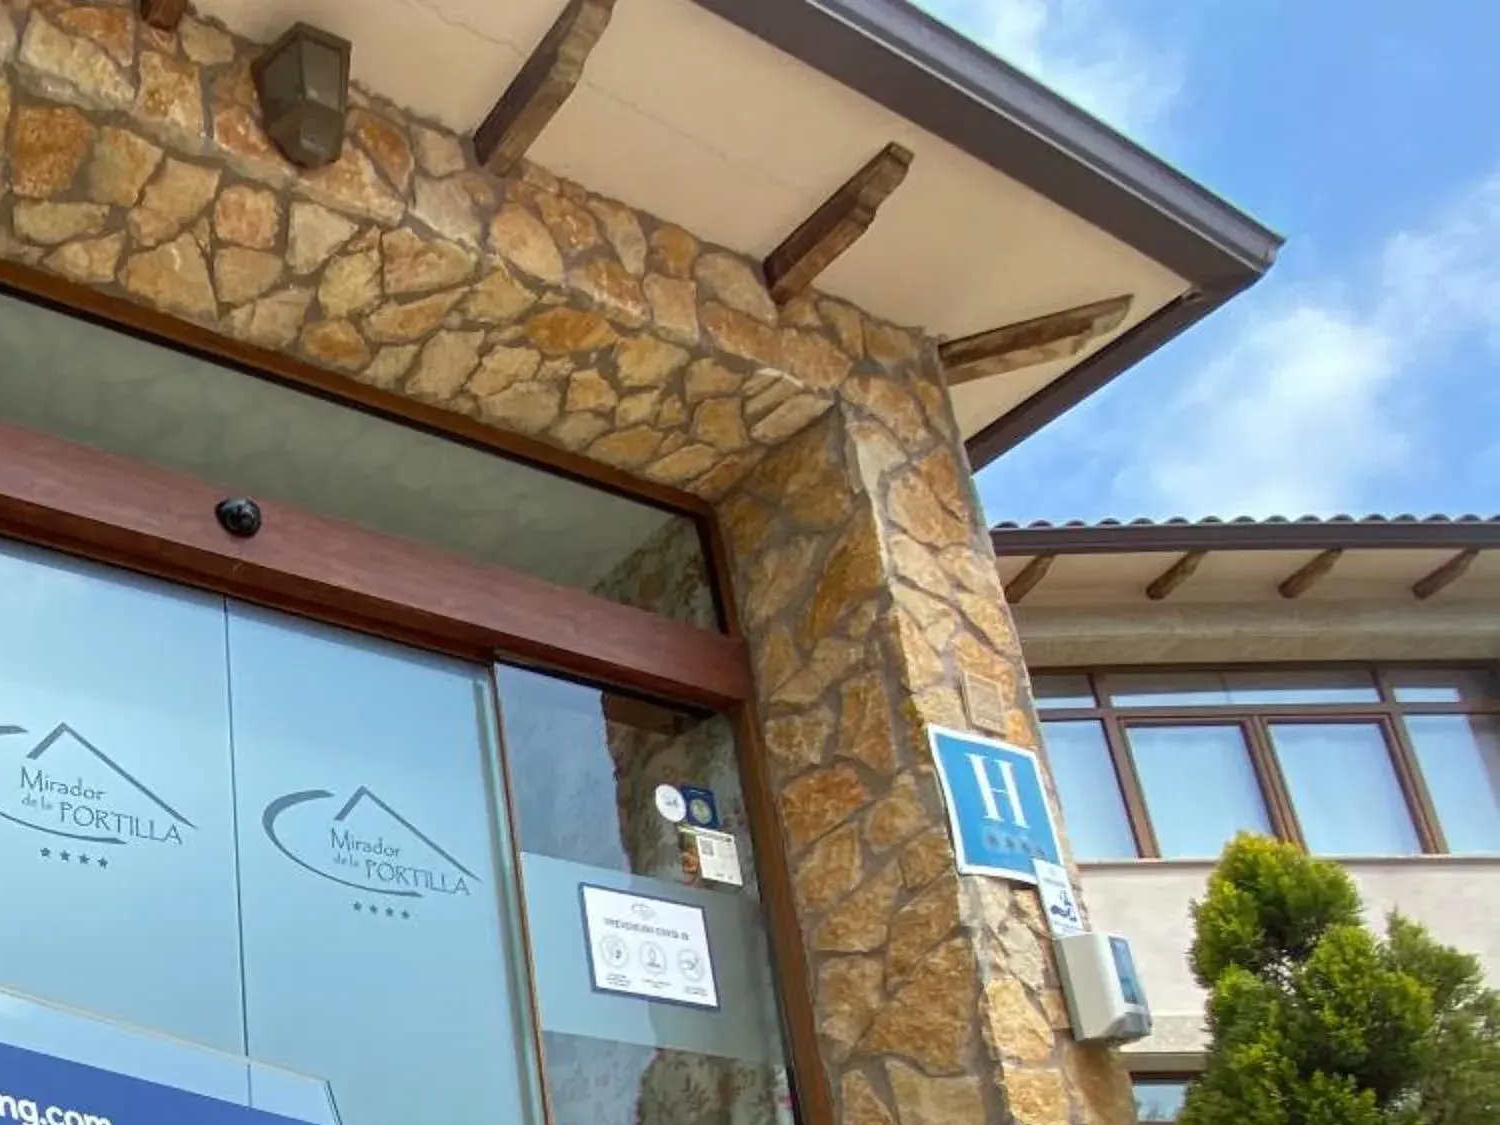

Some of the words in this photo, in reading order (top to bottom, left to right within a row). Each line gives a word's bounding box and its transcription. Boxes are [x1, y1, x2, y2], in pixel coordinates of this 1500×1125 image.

[20, 766, 107, 800] Mirador
[964, 752, 1030, 829] H
[59, 801, 183, 845] PORTILLA
[331, 827, 403, 858] Mirador
[365, 859, 471, 896] PORTILLA
